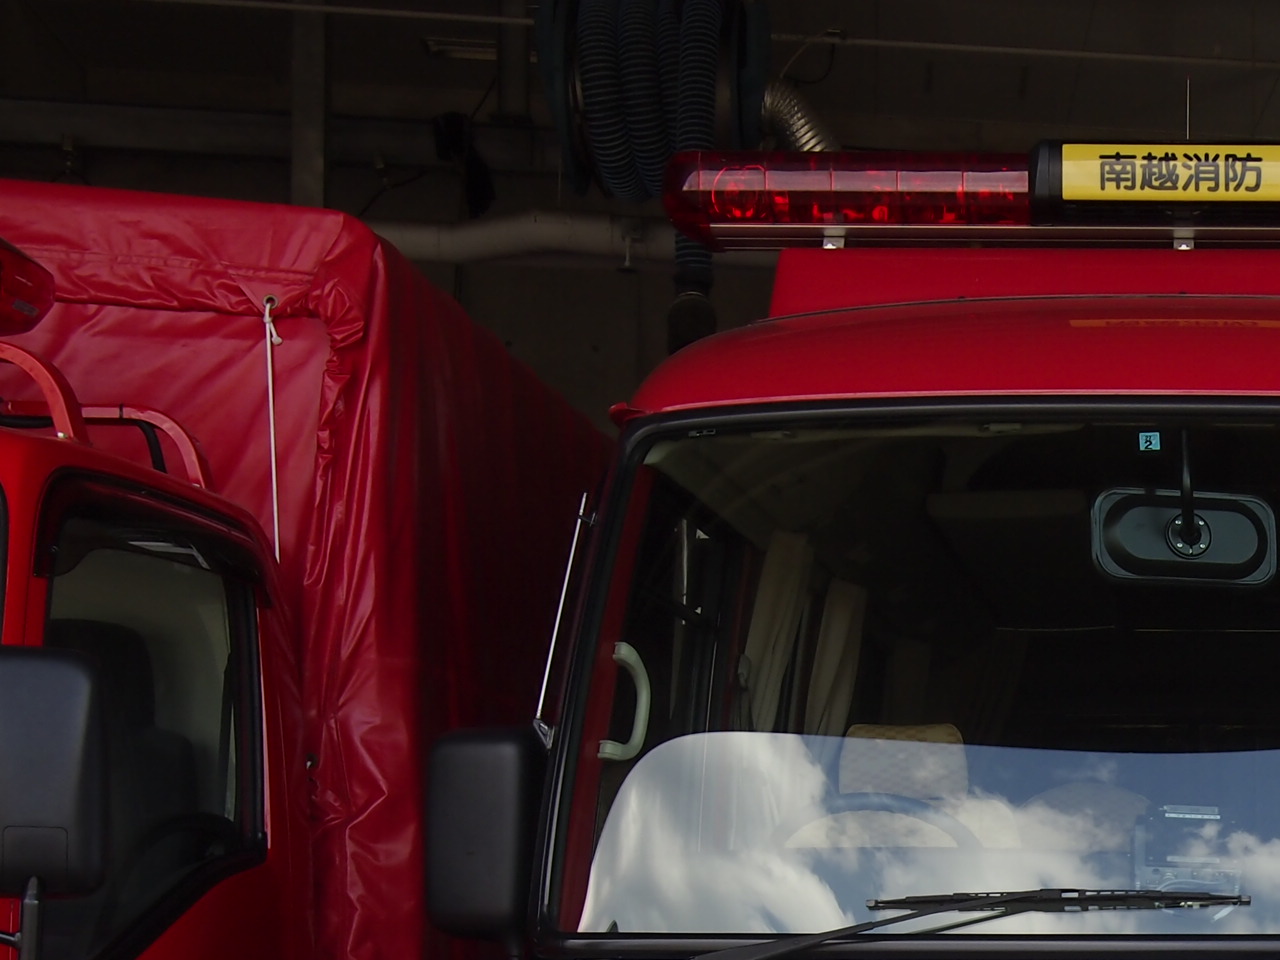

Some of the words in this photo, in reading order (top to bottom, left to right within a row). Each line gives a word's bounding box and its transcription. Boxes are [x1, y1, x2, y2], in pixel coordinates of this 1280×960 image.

[1098, 151, 1263, 193] 南越消防
[1144, 440, 1153, 450] 2
